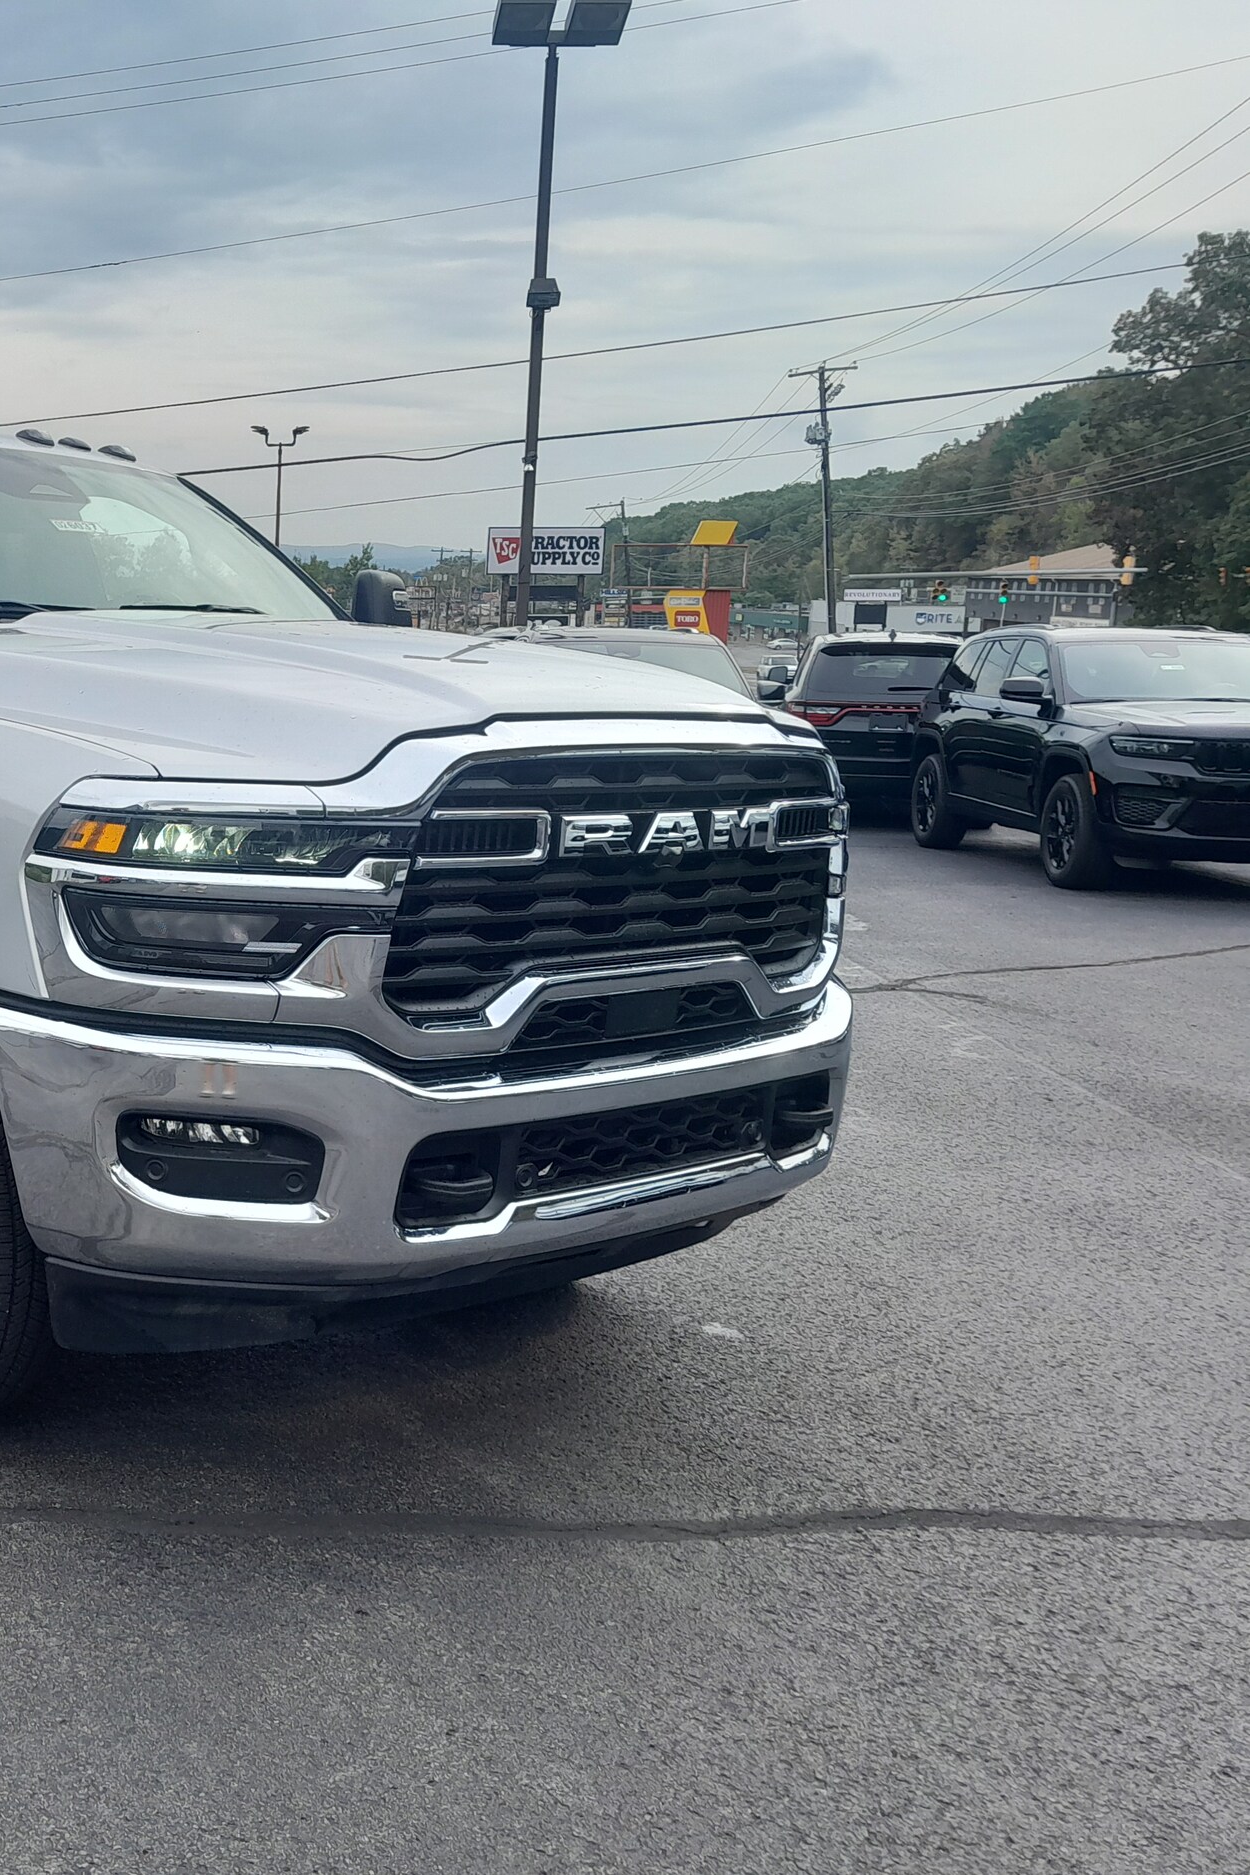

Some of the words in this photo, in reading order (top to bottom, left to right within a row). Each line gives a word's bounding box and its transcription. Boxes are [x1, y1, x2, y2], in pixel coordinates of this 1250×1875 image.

[495, 539, 517, 558] TSC
[531, 536, 600, 550] RACTOR
[530, 551, 580, 565] UPPLY
[928, 613, 952, 624] RITE
[558, 808, 775, 858] RAM
